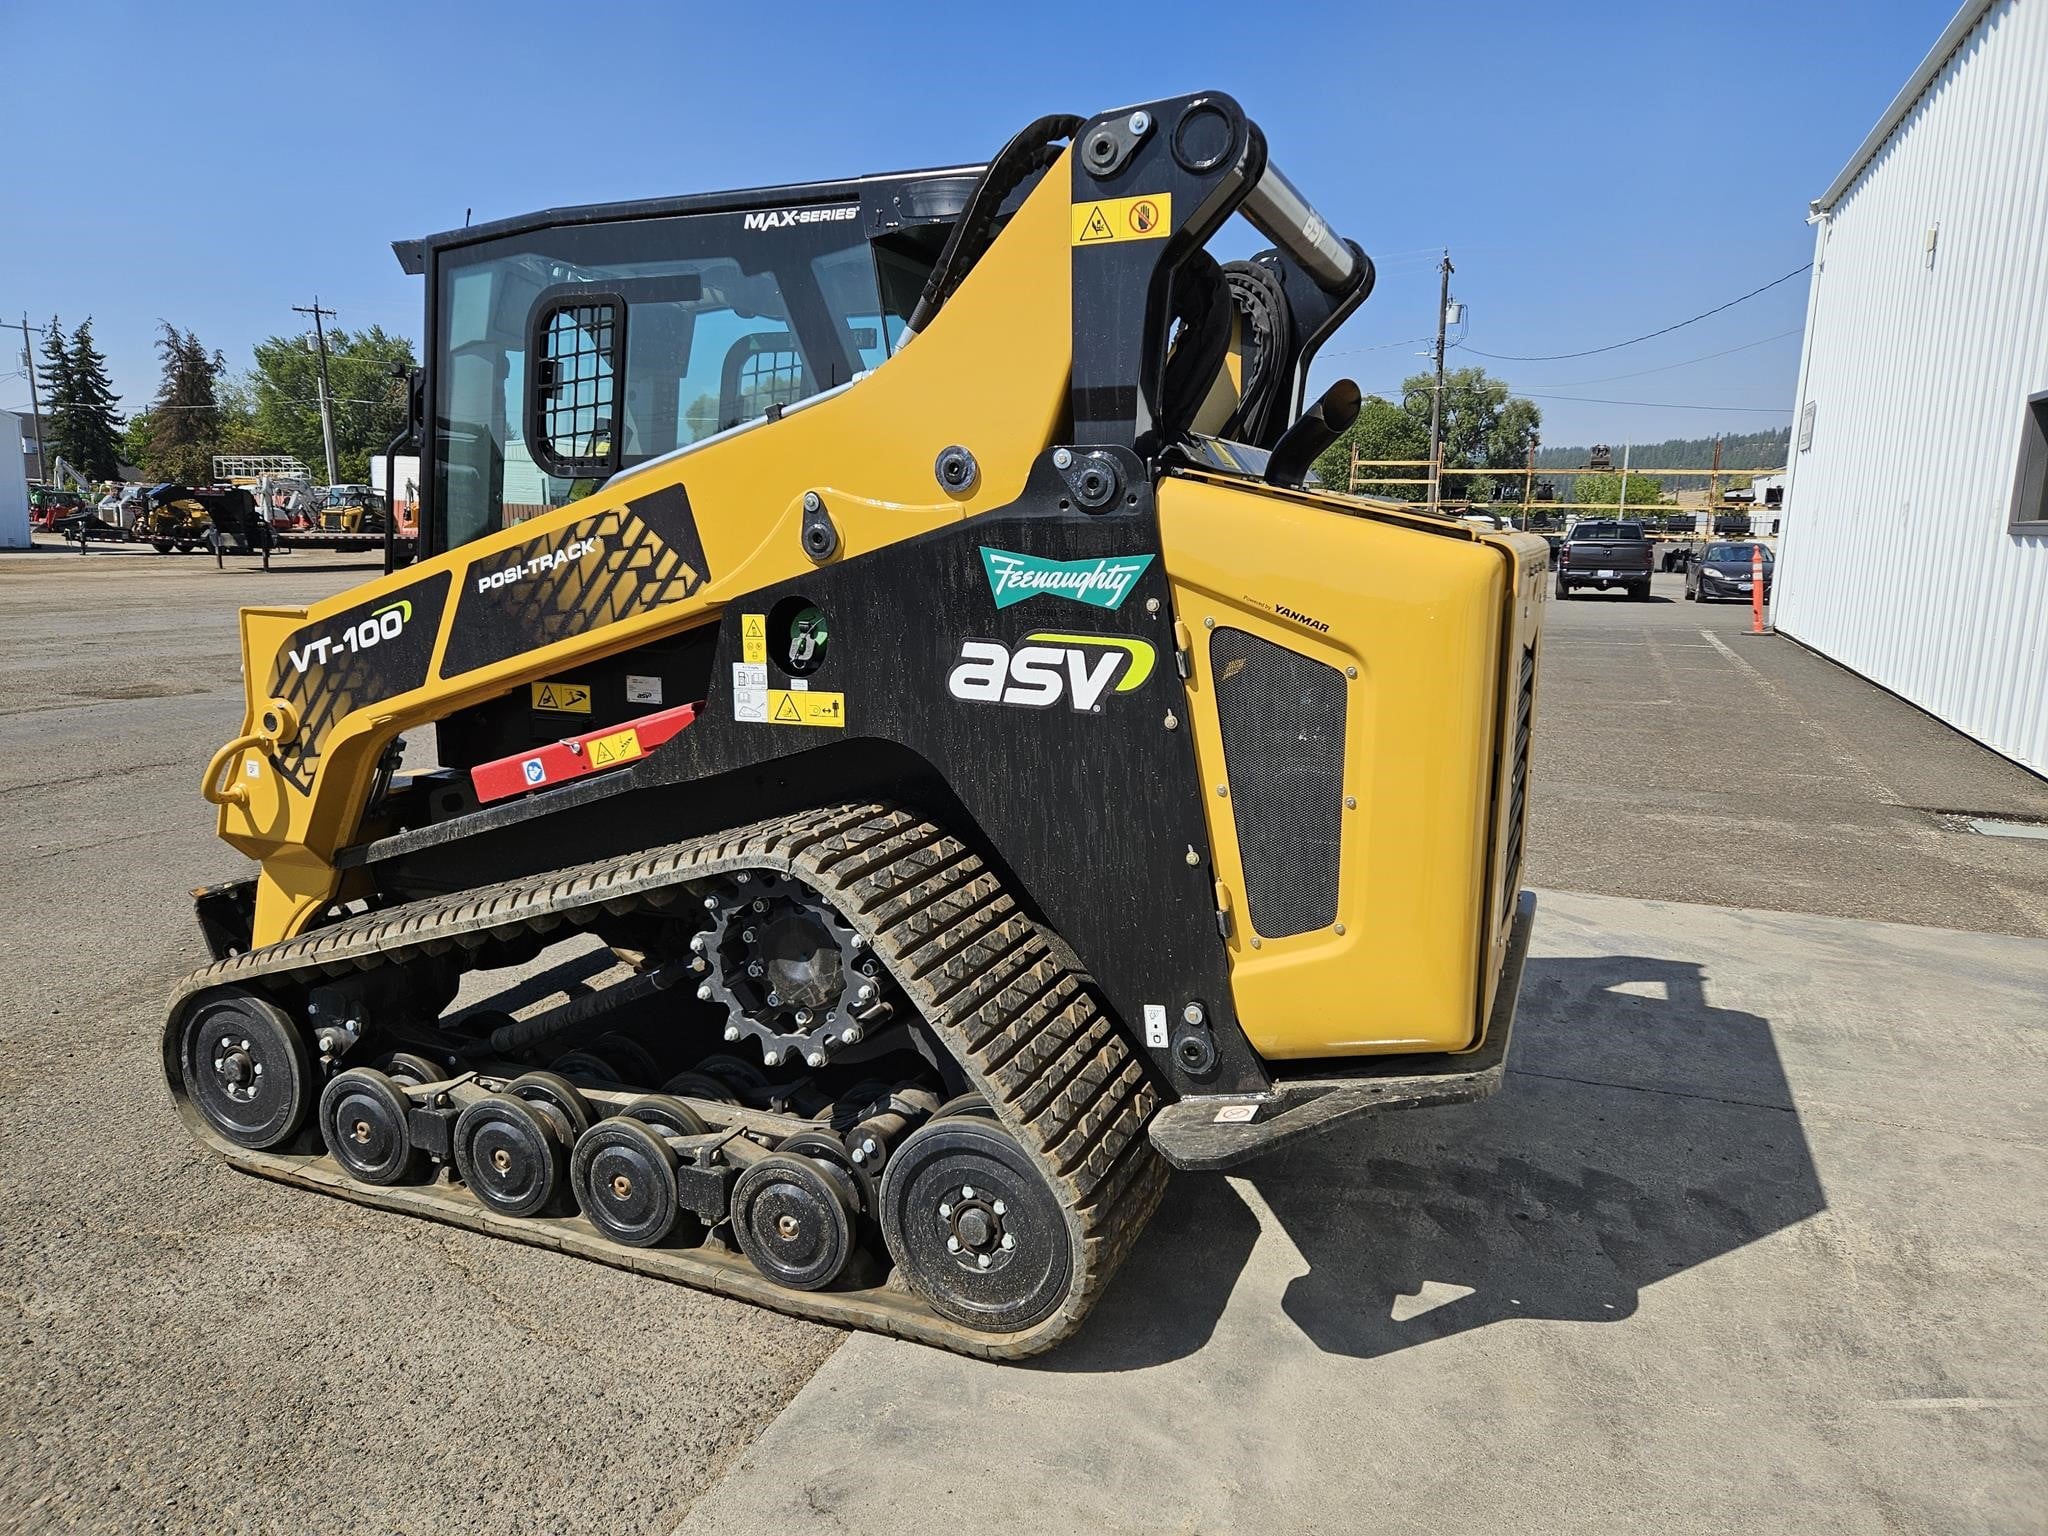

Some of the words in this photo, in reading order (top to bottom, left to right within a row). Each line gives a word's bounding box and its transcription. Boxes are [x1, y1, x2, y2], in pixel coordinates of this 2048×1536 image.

[743, 206, 860, 232] MAX-SERIES
[478, 536, 597, 594] POSI-TRACK
[989, 554, 1141, 607] Feenaughty
[288, 610, 403, 673] VT-100
[1275, 603, 1330, 632] YANMAR
